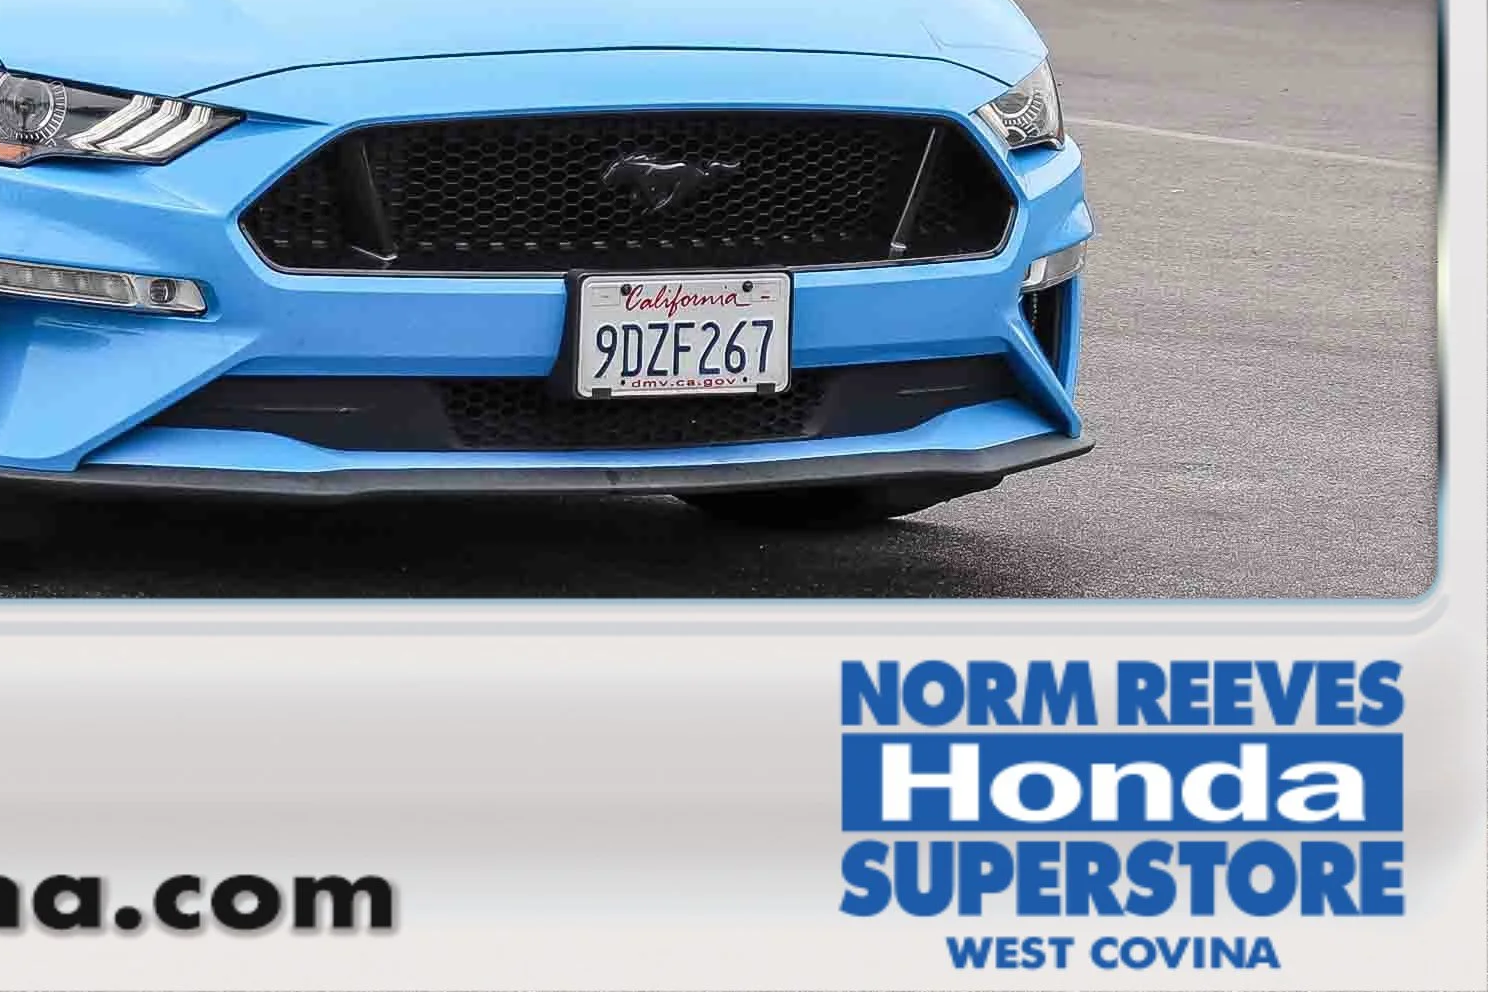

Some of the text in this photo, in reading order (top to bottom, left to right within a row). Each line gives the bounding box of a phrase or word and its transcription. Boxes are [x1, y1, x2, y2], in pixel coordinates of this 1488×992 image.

[625, 283, 752, 318] California
[594, 320, 774, 378] 9DZF267
[631, 377, 736, 389] dmv.ca.gov
